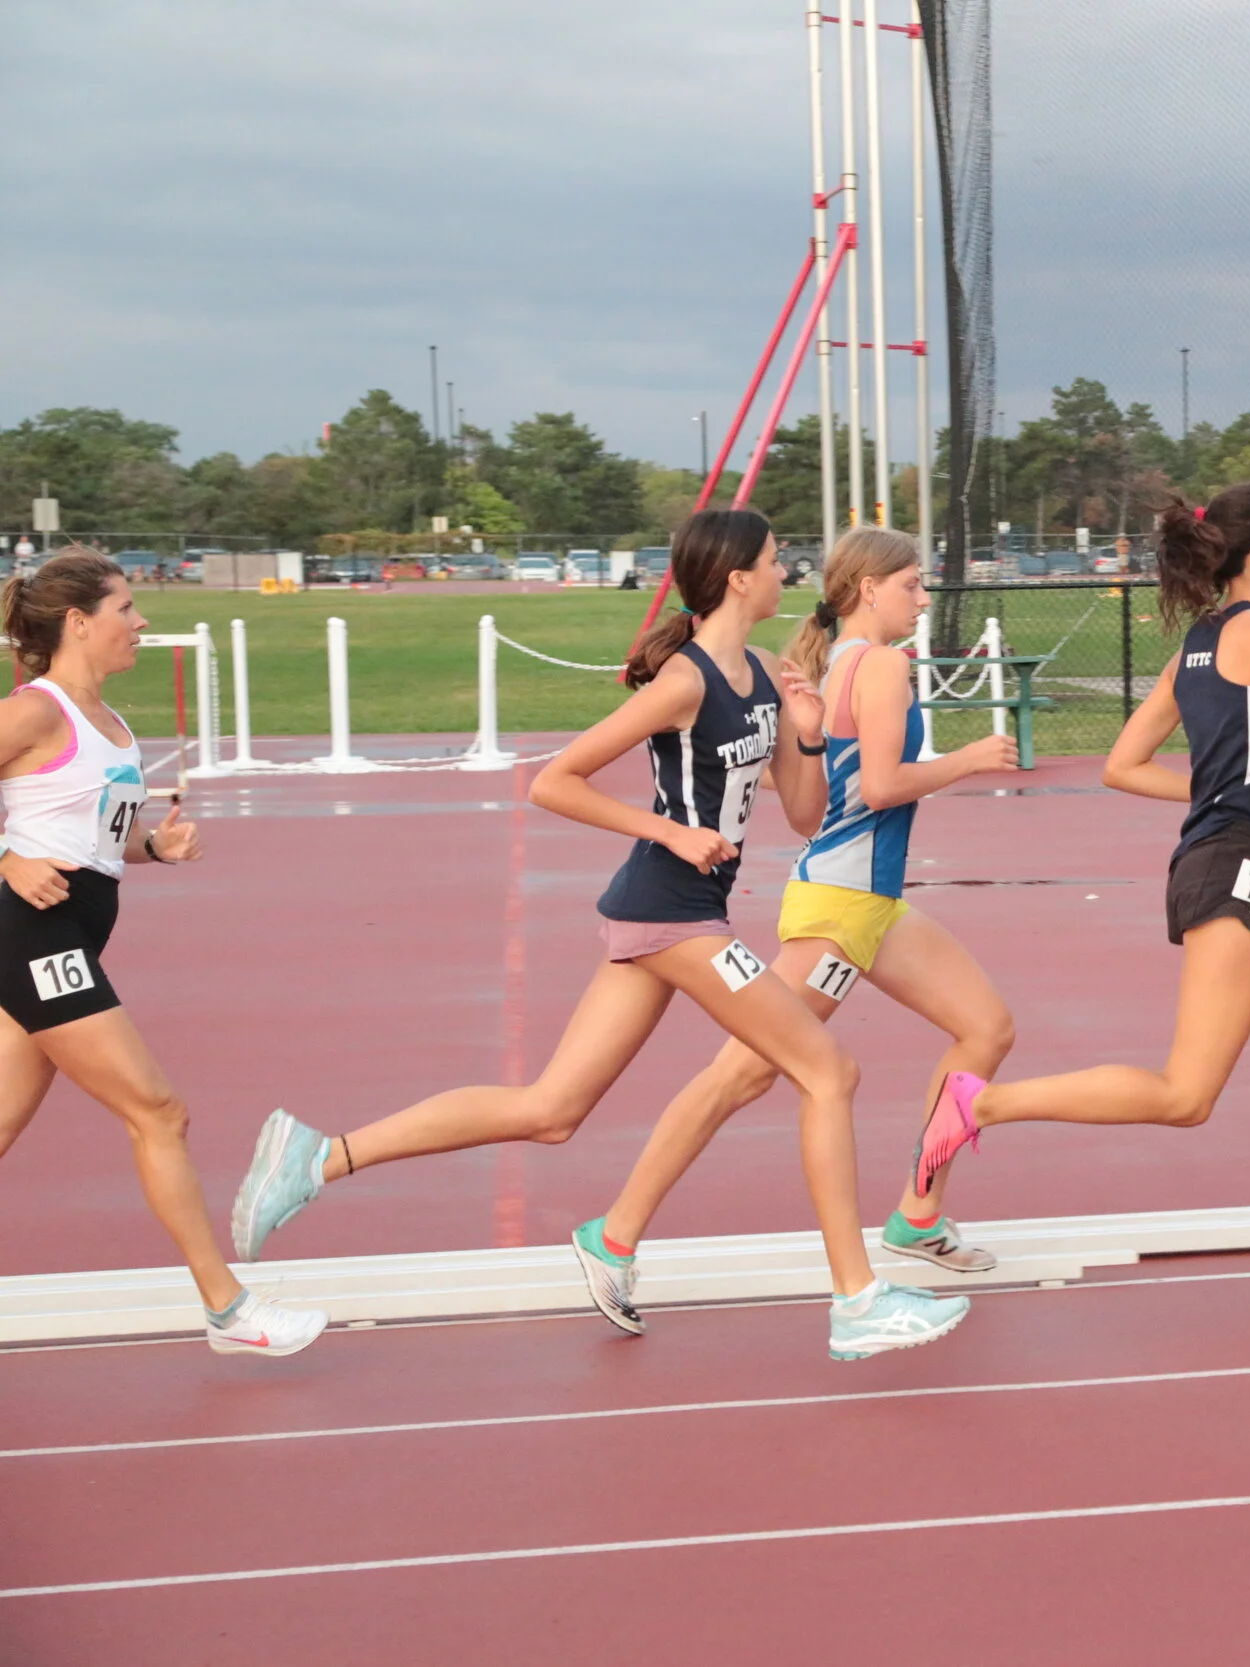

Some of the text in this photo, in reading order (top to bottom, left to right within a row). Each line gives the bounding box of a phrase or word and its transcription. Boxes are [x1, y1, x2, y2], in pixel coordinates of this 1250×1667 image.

[1186, 651, 1212, 669] UTTC
[42, 953, 84, 994] 16
[724, 942, 760, 981] 13
[819, 960, 853, 996] 11
